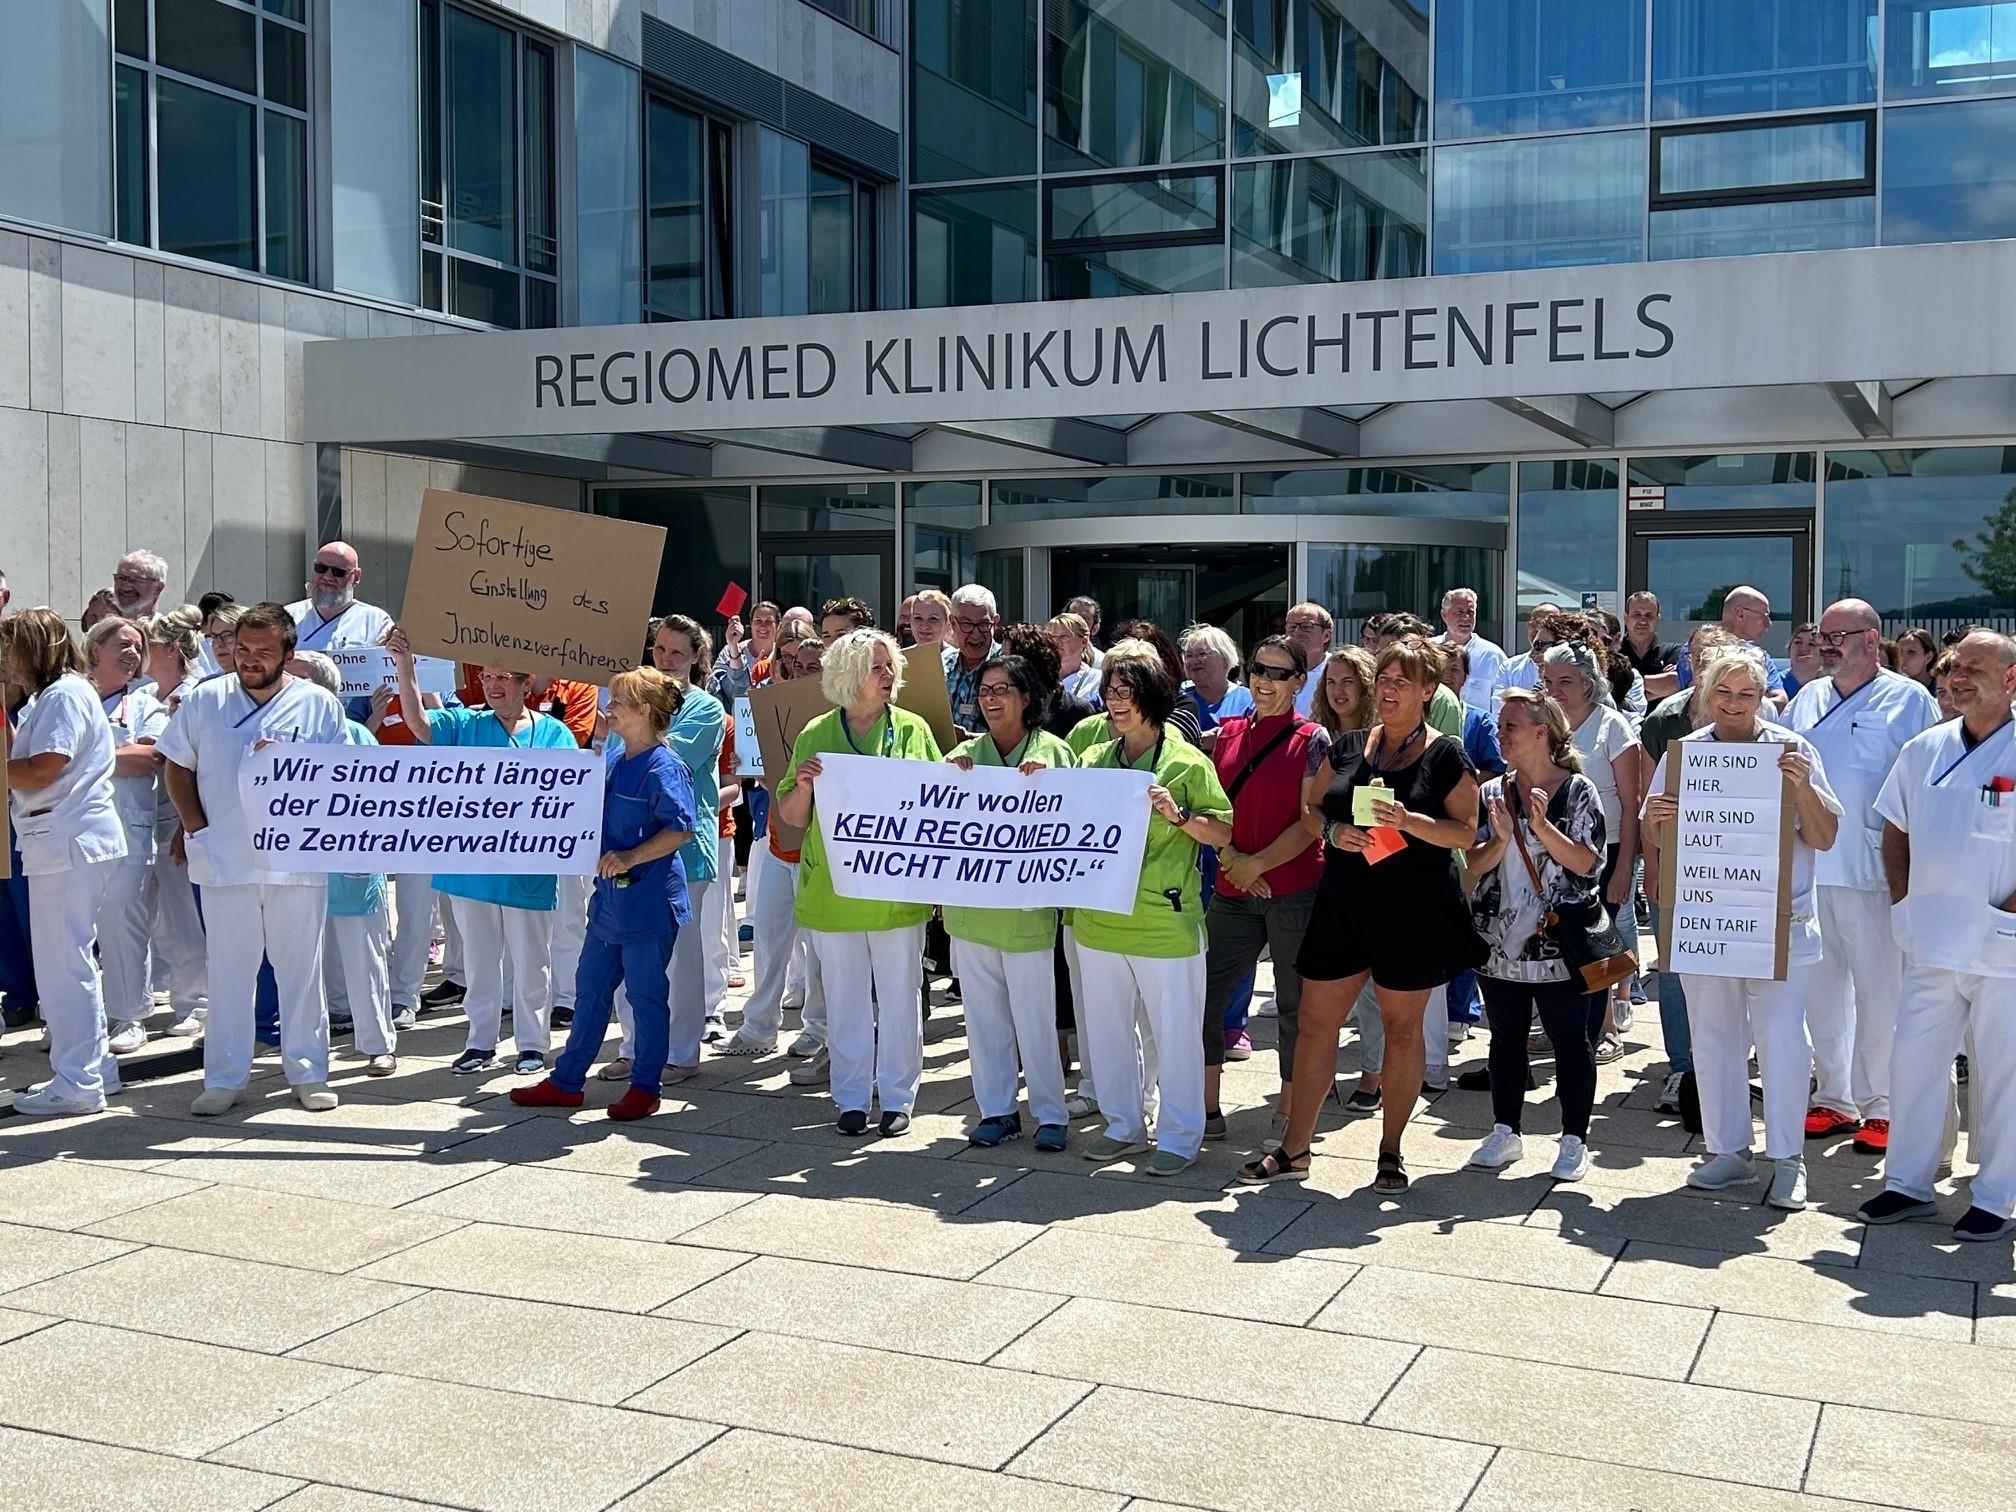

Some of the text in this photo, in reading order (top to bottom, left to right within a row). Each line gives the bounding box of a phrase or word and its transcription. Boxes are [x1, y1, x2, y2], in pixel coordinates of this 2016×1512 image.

[535, 293, 1674, 408] REGIOMED KLINIKUM LICHTENFELS
[434, 511, 554, 567] Sofortige
[470, 570, 609, 615] Einstellung des
[332, 653, 367, 665] Ohne
[1688, 755, 1758, 769] WIR SIND
[253, 757, 592, 791] „Wir sind nicht länger
[1686, 778, 1724, 793] HIER,
[268, 793, 575, 819] der Dienstleister für
[899, 783, 1063, 814] „Wir wollen
[1685, 810, 1755, 824] WIR SIND
[253, 827, 290, 851] die
[833, 813, 1122, 849] KEIN REGIOMED 2.0
[1684, 834, 1723, 848] LAUT,
[843, 850, 950, 879] -NICHT
[956, 857, 1012, 883] MIT
[1683, 865, 1761, 882] WEIL MAN
[1682, 889, 1713, 903] UNS
[1680, 916, 1758, 932] DEN TARIF
[1678, 941, 1727, 956] KLAUT
